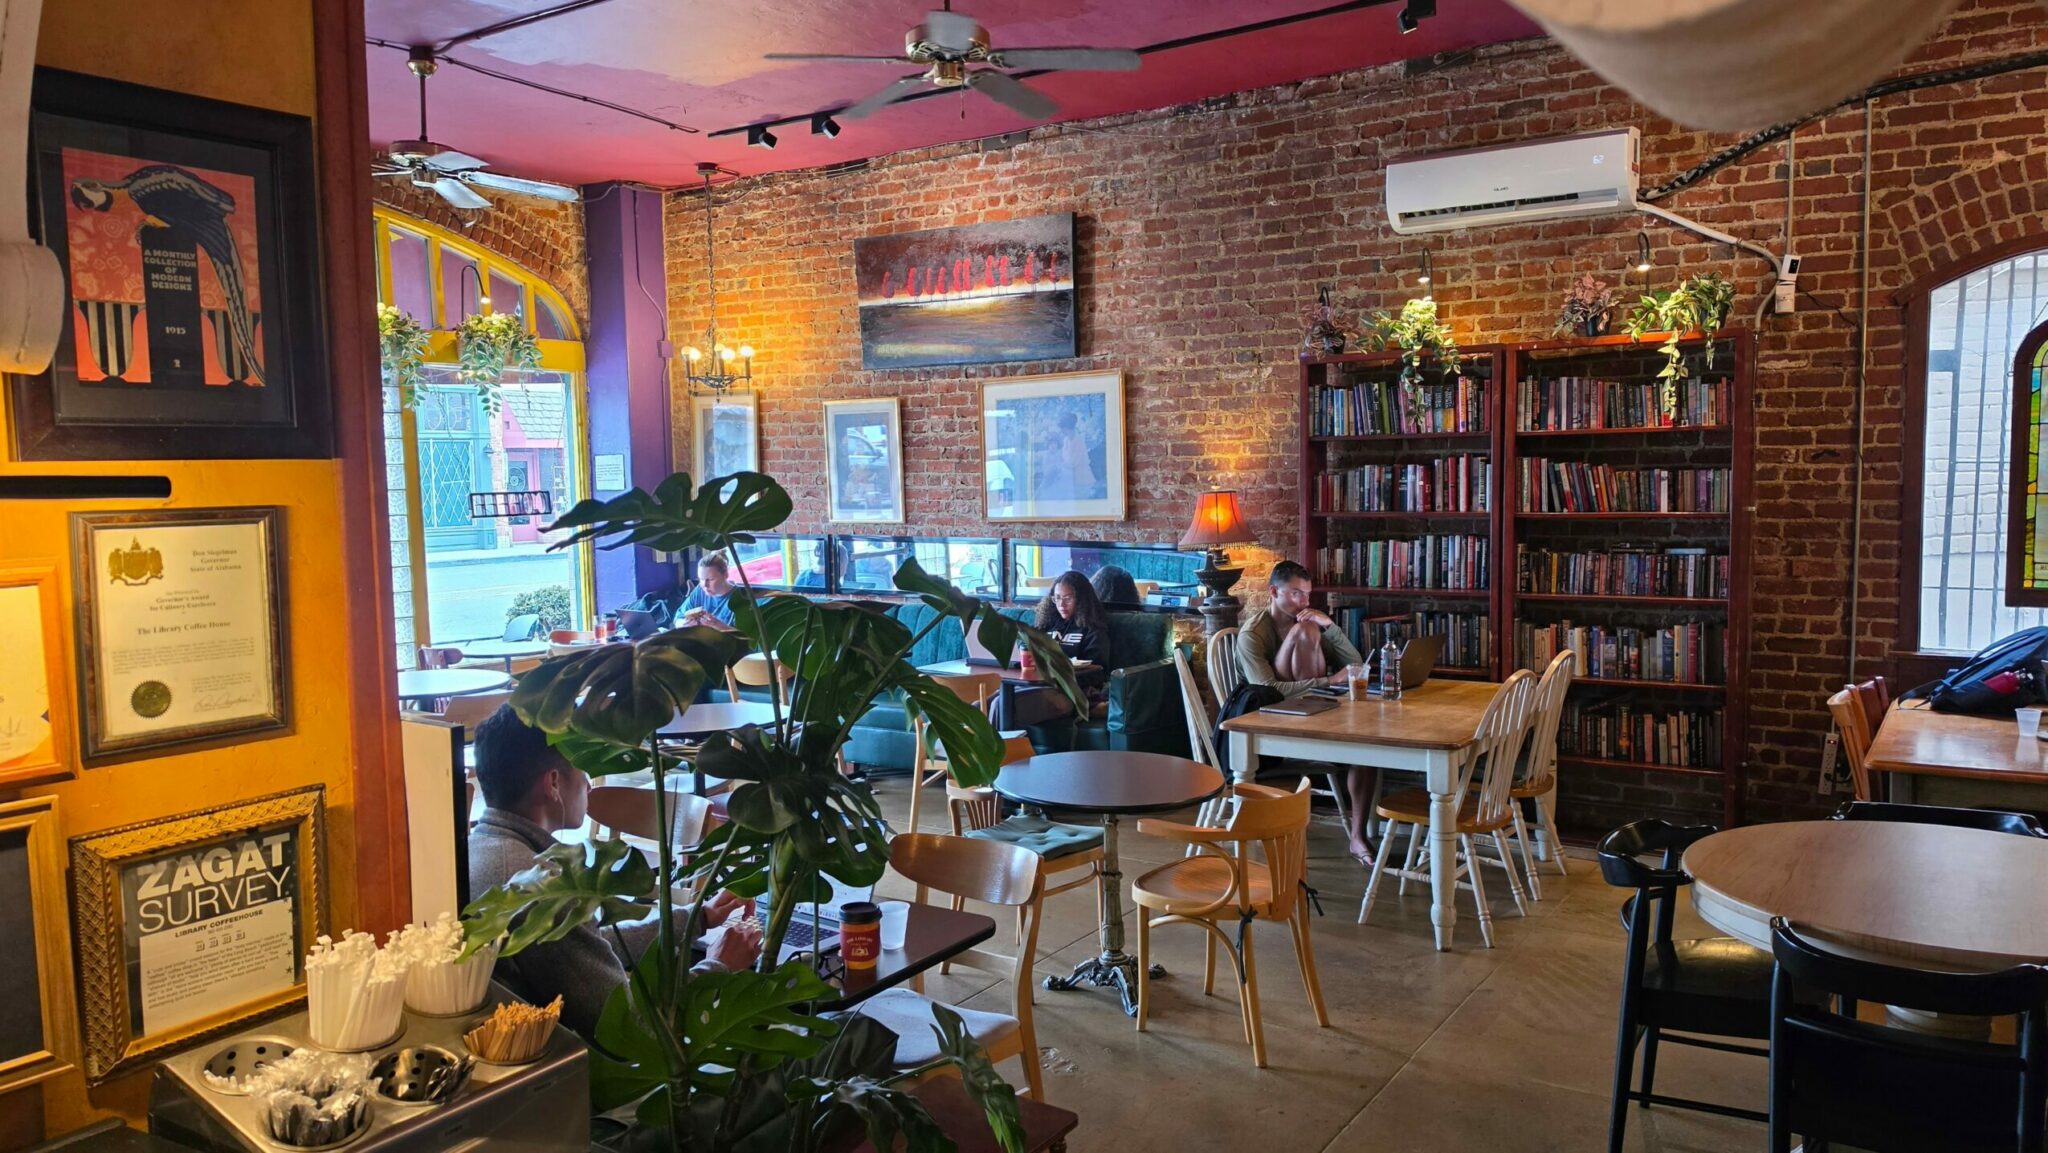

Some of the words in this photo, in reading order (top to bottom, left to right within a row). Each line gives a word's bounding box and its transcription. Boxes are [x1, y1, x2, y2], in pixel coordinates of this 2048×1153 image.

[153, 249, 195, 260] MONTHLY
[144, 257, 197, 268] COLLECTION
[151, 273, 191, 282] MODERN
[152, 281, 192, 291] DESIGNS
[153, 625, 182, 634] Library
[184, 623, 207, 631] Coffee
[209, 621, 231, 629] House
[137, 832, 290, 900] ZAGAT
[139, 865, 290, 933] SURVEY
[175, 924, 207, 938] LIBRARY
[209, 909, 263, 929] COFFEEHOUSE
